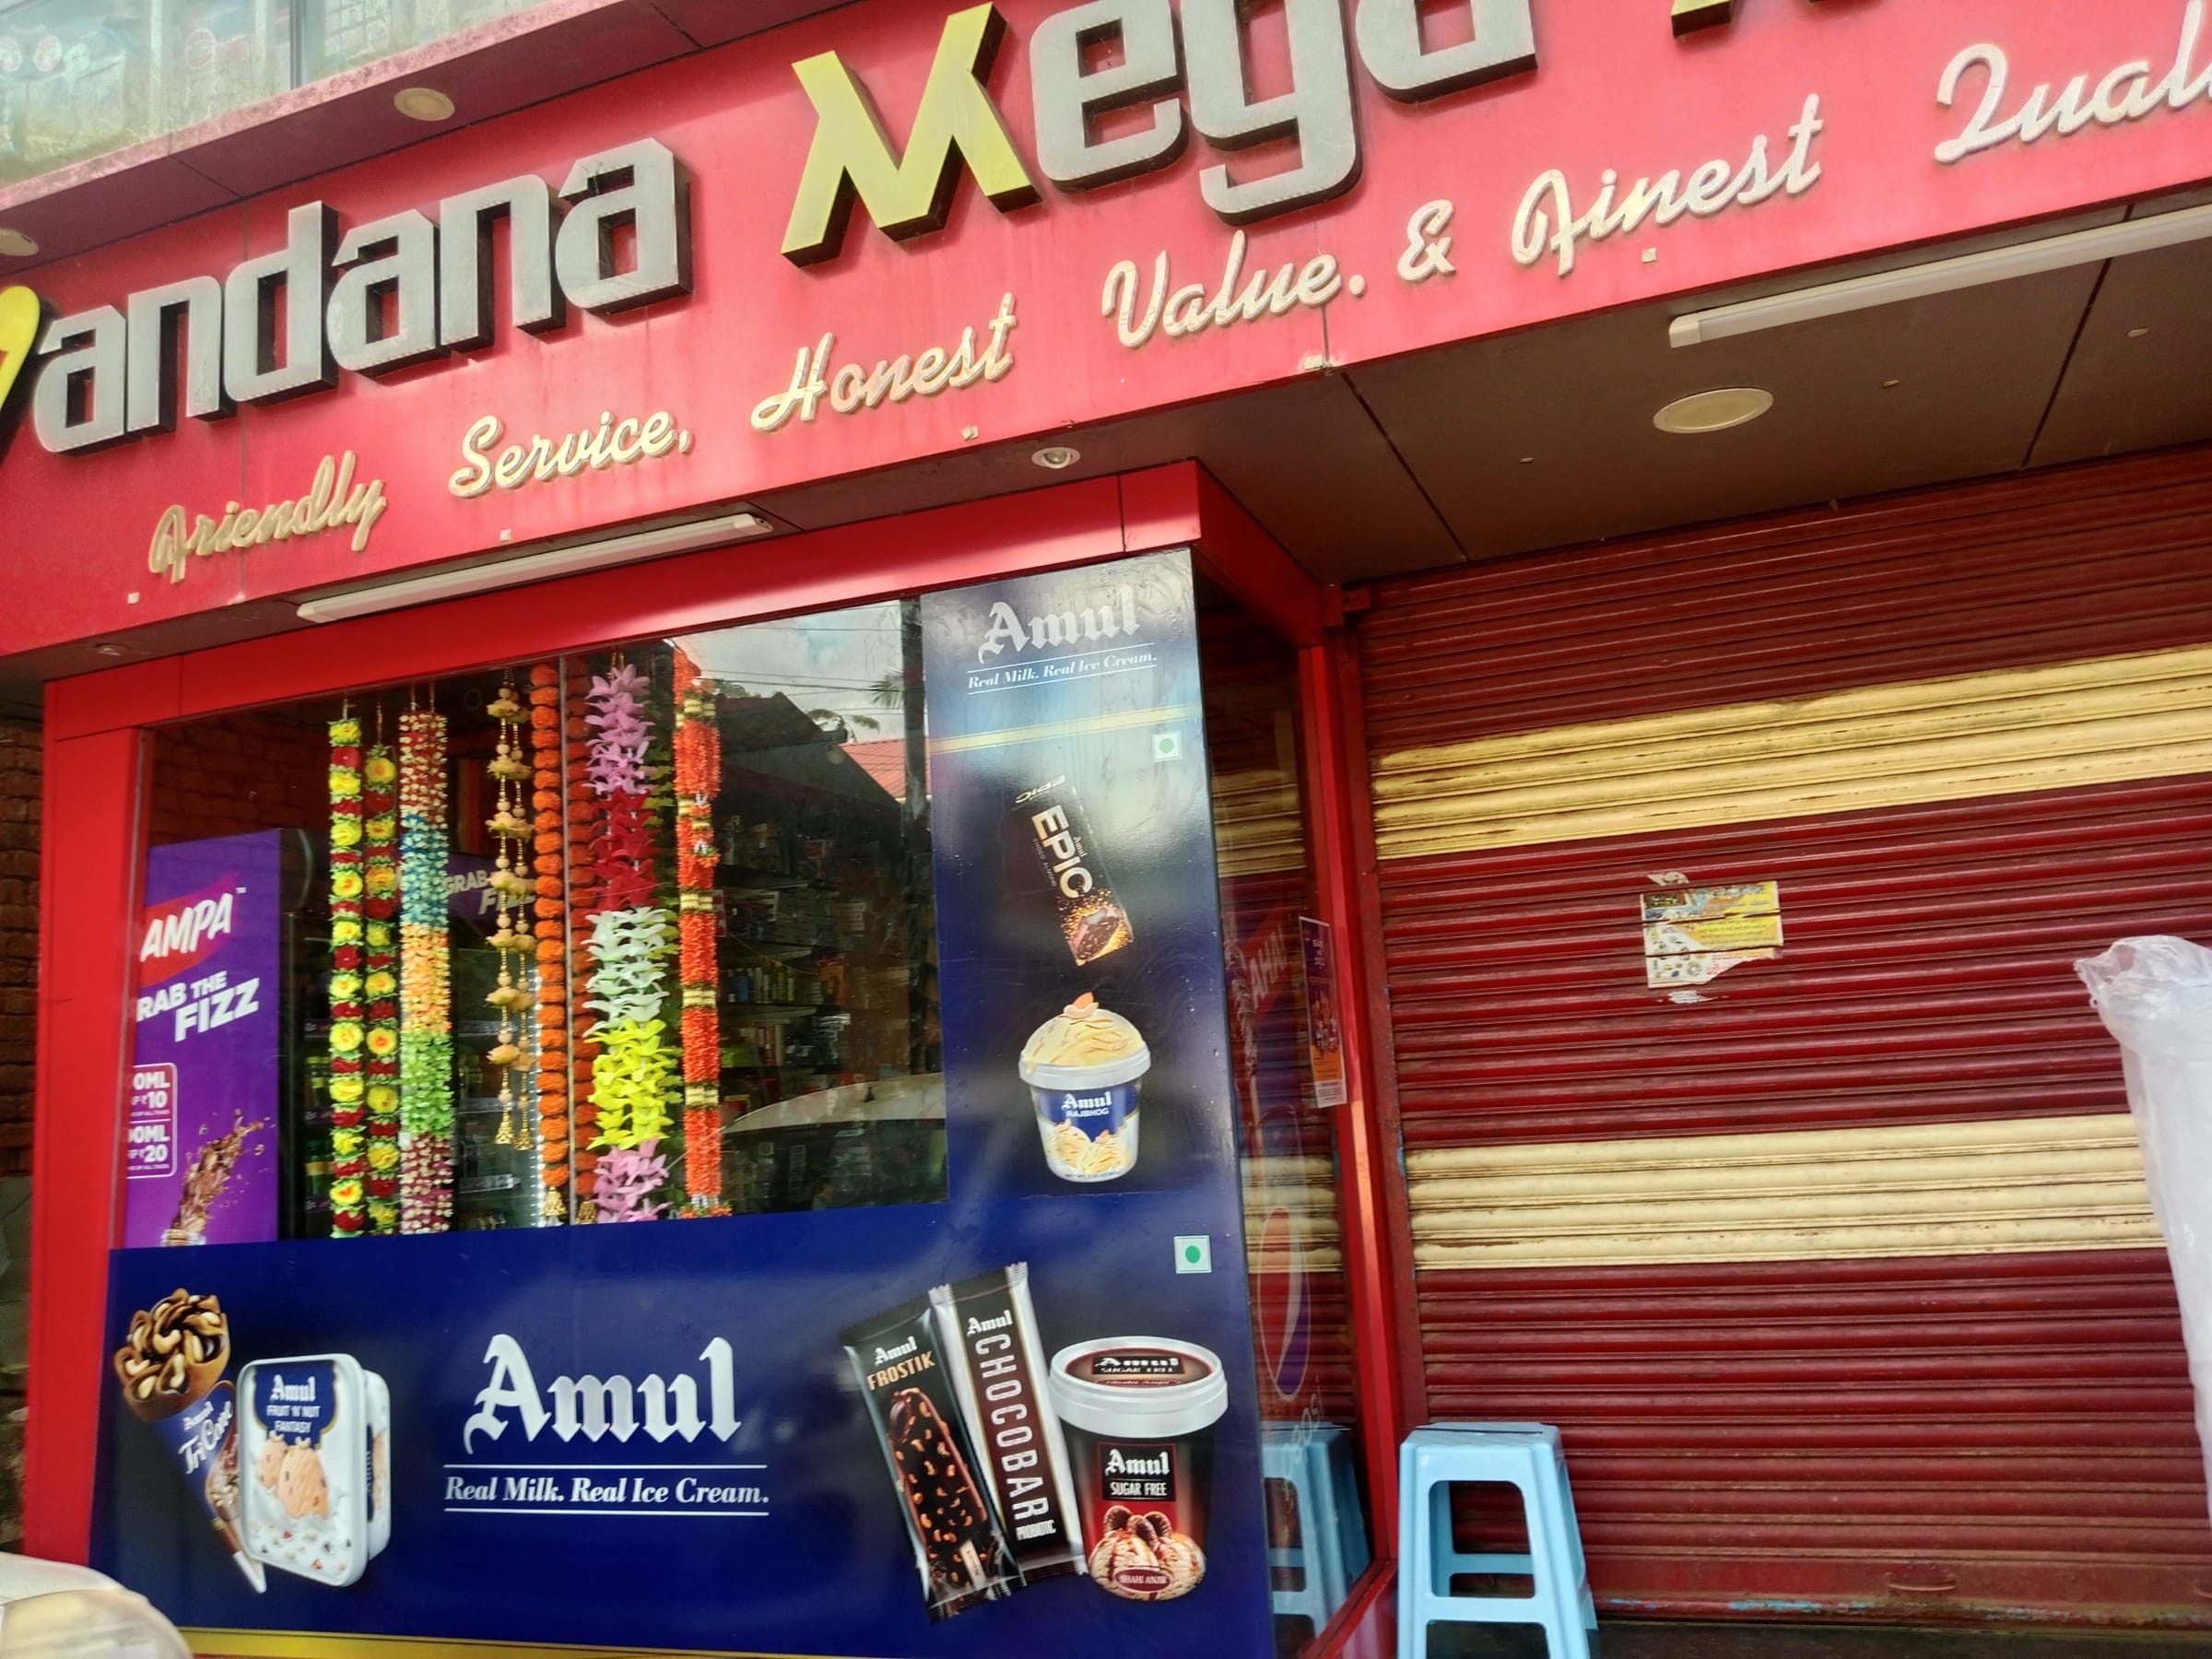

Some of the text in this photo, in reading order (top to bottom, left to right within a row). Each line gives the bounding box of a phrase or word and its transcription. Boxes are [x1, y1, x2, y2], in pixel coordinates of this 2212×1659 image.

[148, 451, 386, 582] Friendly
[449, 411, 691, 498] Service,
[750, 292, 1016, 431] Honest
[1396, 200, 1455, 281] &
[1511, 93, 1823, 276] Finest
[1934, 0, 2212, 164] Qual
[978, 584, 1140, 664] Amul
[968, 653, 1157, 689] Real Milk. Real Ice Cream.
[1031, 805, 1093, 899] EPIC
[140, 892, 234, 962] AMPA
[136, 971, 227, 1022] RAB THE
[175, 977, 260, 1042] FIZZ
[133, 1071, 171, 1090] 0ML
[1061, 1091, 1112, 1112] Amul
[128, 1124, 171, 1144] 0ML
[967, 1310, 1013, 1336] Amul
[875, 1335, 918, 1366] Amul
[1094, 1357, 1179, 1367] Amul
[866, 1351, 936, 1391] FROSTIK
[269, 1374, 316, 1402] Amul
[464, 1334, 742, 1454] Amul
[975, 1334, 1050, 1520] CHOCOBAR
[1105, 1449, 1171, 1477] Amul
[444, 1477, 770, 1503] Real Milk. Real Ice Cream.
[1110, 1481, 1168, 1496] SUGAR FREE
